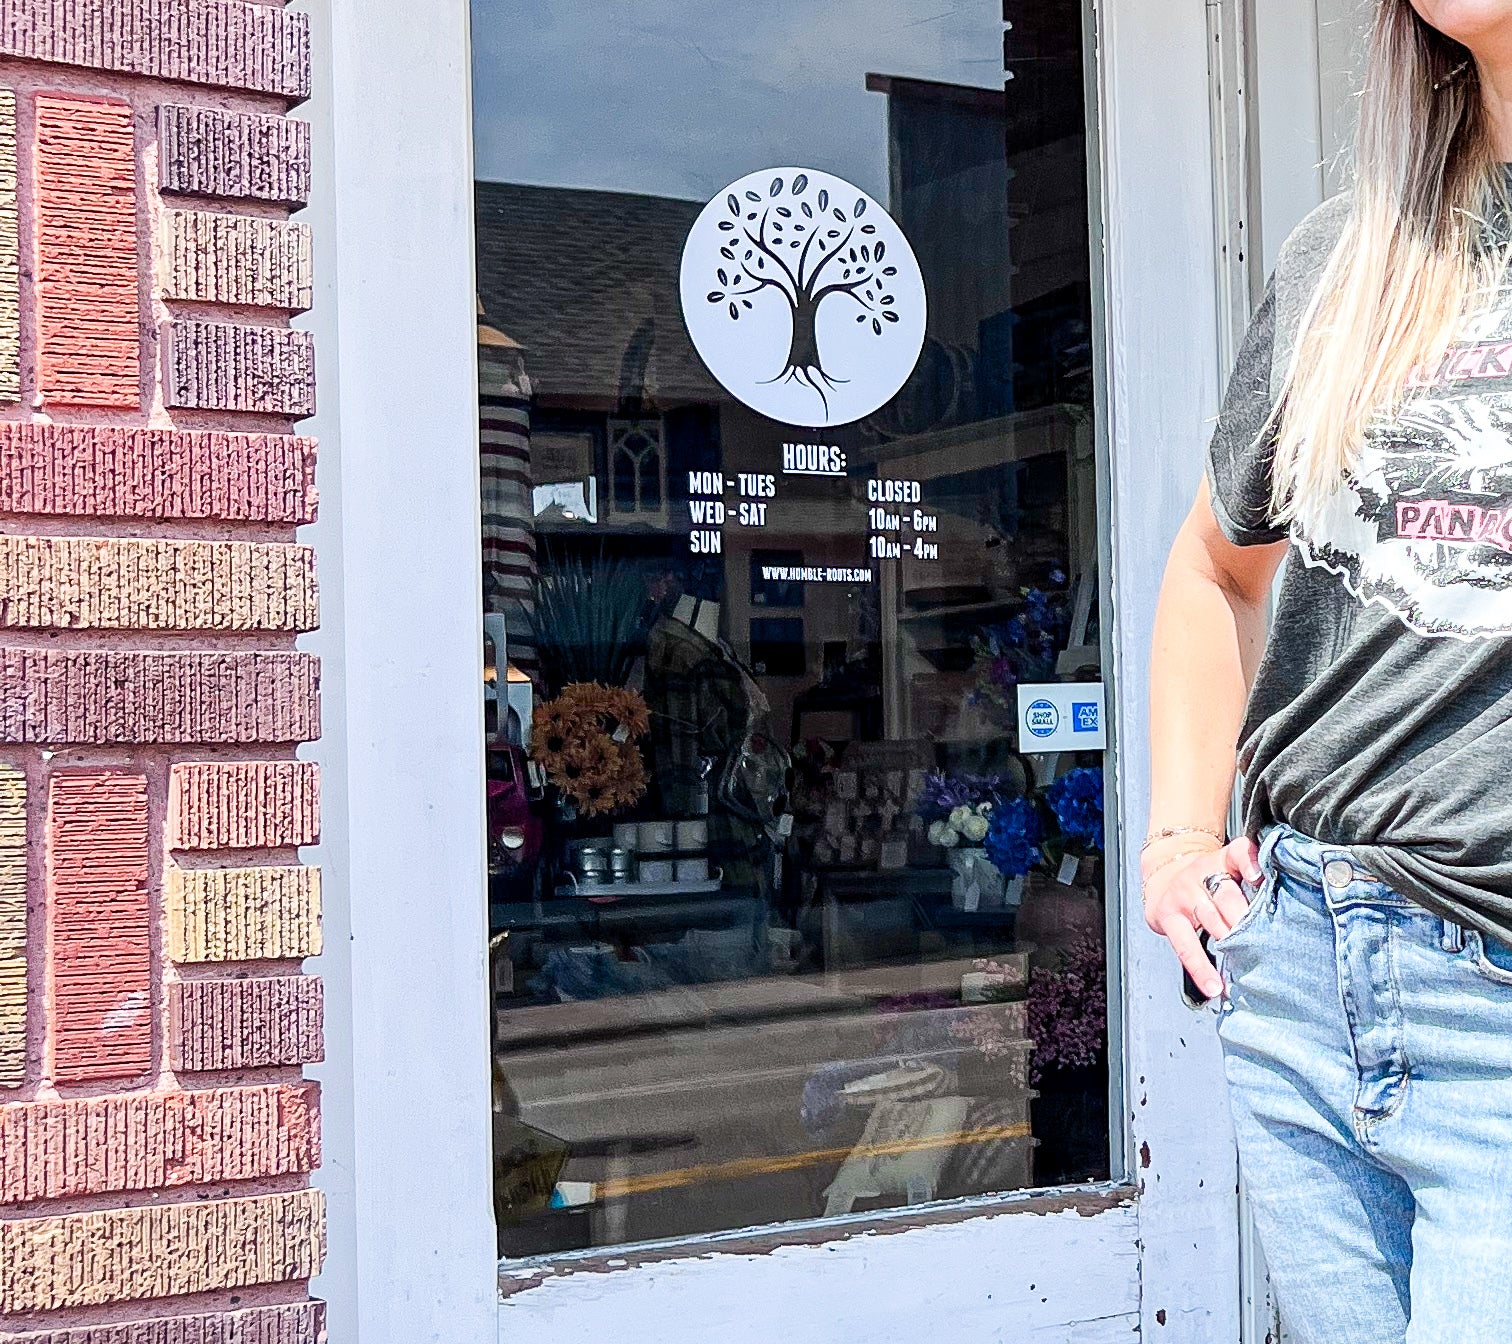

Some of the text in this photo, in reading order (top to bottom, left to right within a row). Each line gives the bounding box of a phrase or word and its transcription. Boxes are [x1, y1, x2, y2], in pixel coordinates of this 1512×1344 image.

[782, 443, 848, 474] HOURS:
[688, 471, 724, 495] MON
[738, 473, 776, 498] TUES
[867, 479, 921, 504] CLOSED
[688, 500, 725, 525] WED
[739, 502, 768, 526] SAT
[868, 507, 900, 532] 10AM
[913, 509, 938, 533] 6PM
[689, 529, 722, 554] SUN
[868, 535, 901, 560] 10AM
[913, 537, 939, 560] 4PM
[761, 566, 872, 583] WWW.HUMBLE-ROOTS.COM
[1079, 706, 1098, 717] AM
[1082, 717, 1098, 726] EX
